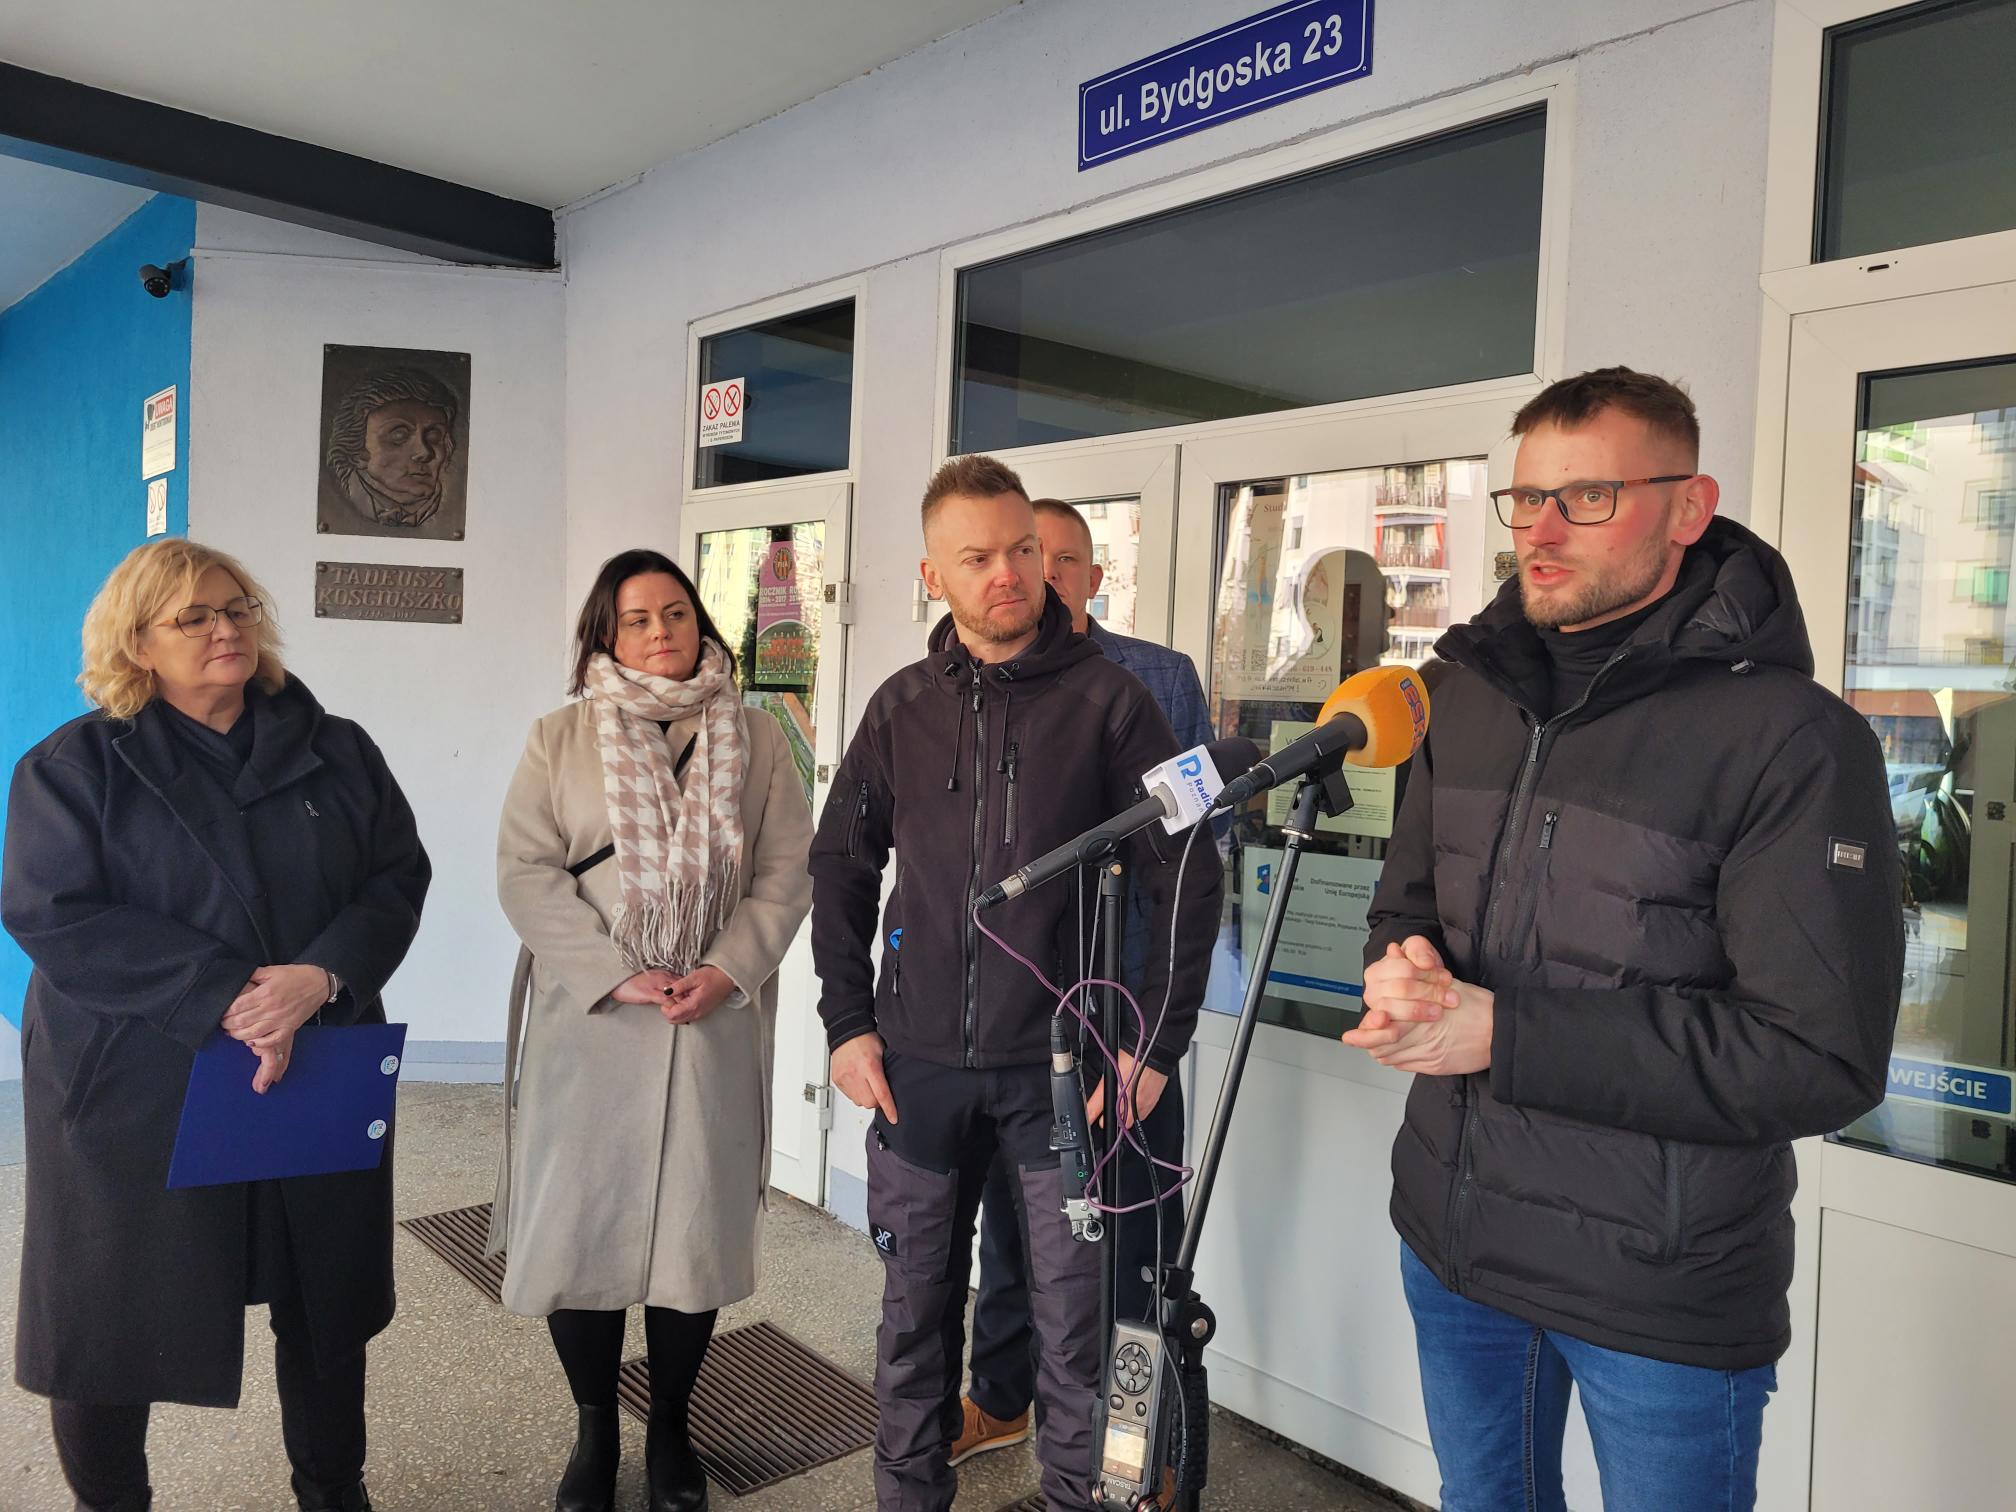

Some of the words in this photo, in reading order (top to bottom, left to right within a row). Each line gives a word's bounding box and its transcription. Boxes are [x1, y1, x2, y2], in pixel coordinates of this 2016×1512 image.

[1100, 94, 1130, 136] ul.
[1141, 41, 1291, 124] Bydgoska
[1302, 14, 1343, 65] 23
[702, 424, 719, 432] ZAKAZ
[720, 419, 740, 429] PALENIA
[331, 567, 446, 589] TADEUSZ
[760, 586, 787, 597] ROCZNIK
[1889, 1066, 1988, 1100] WEJŚCIE
